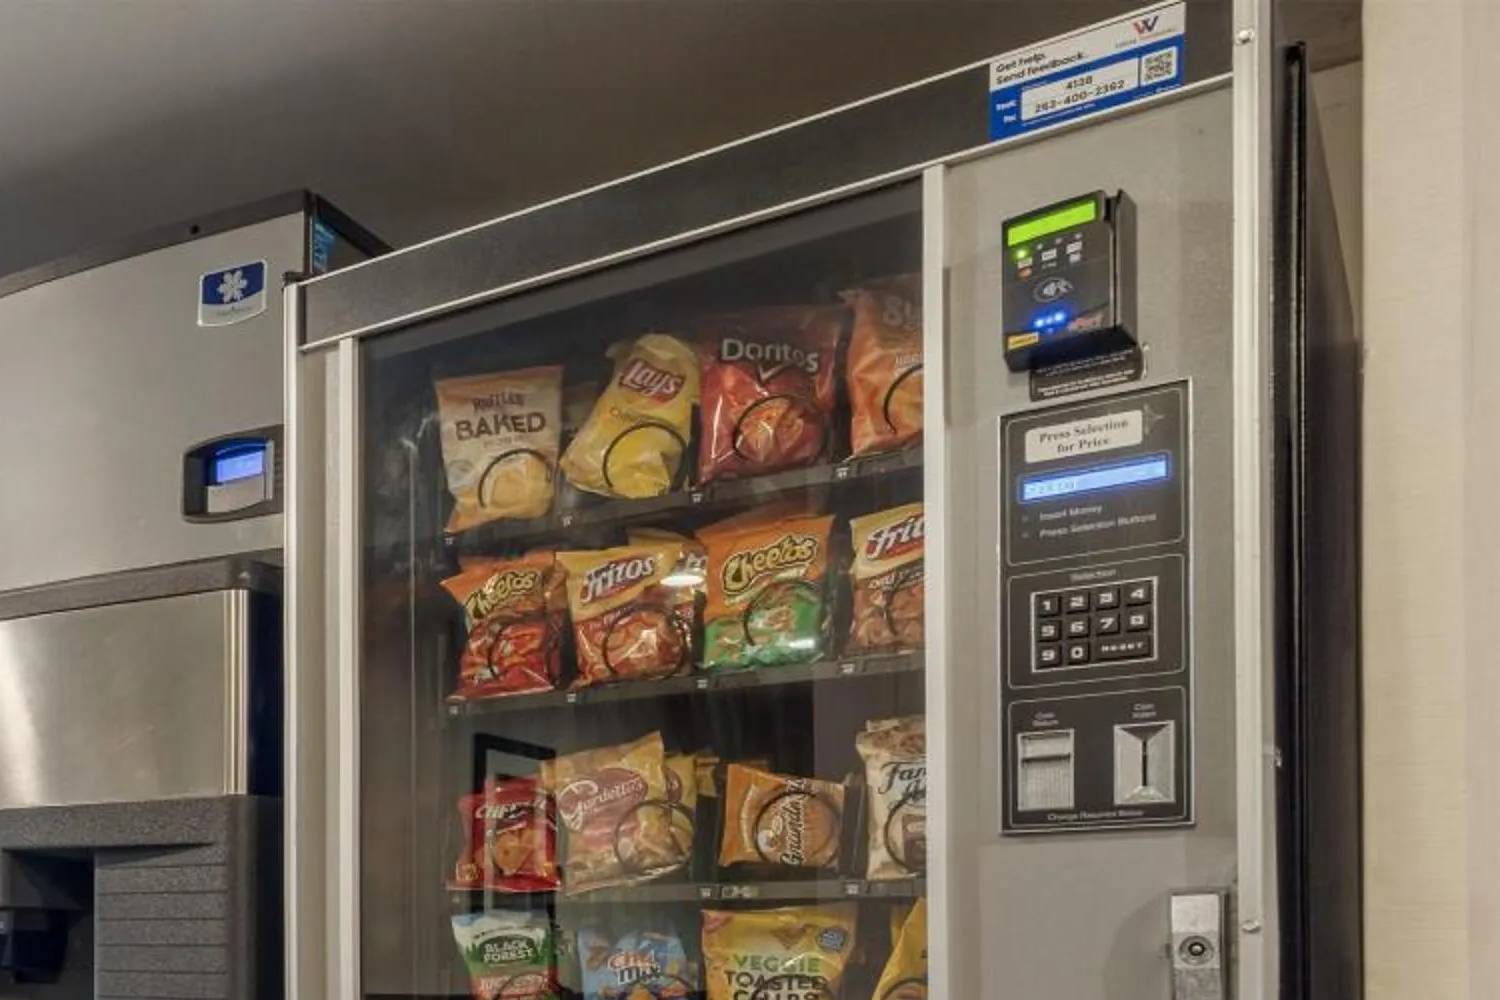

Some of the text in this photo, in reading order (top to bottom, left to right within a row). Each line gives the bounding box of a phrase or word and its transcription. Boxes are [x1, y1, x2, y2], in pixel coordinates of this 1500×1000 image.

[720, 337, 819, 373] Doritos
[455, 411, 547, 442] BAKED
[1038, 418, 1129, 443] Press Selection
[1078, 438, 1110, 449] Price
[721, 535, 818, 595] Cheetos
[581, 556, 655, 602] Fritos
[483, 950, 533, 963] FOREST
[485, 939, 530, 952] BLACK
[733, 953, 821, 973] VEGGIE
[724, 970, 828, 991] TOASTED
